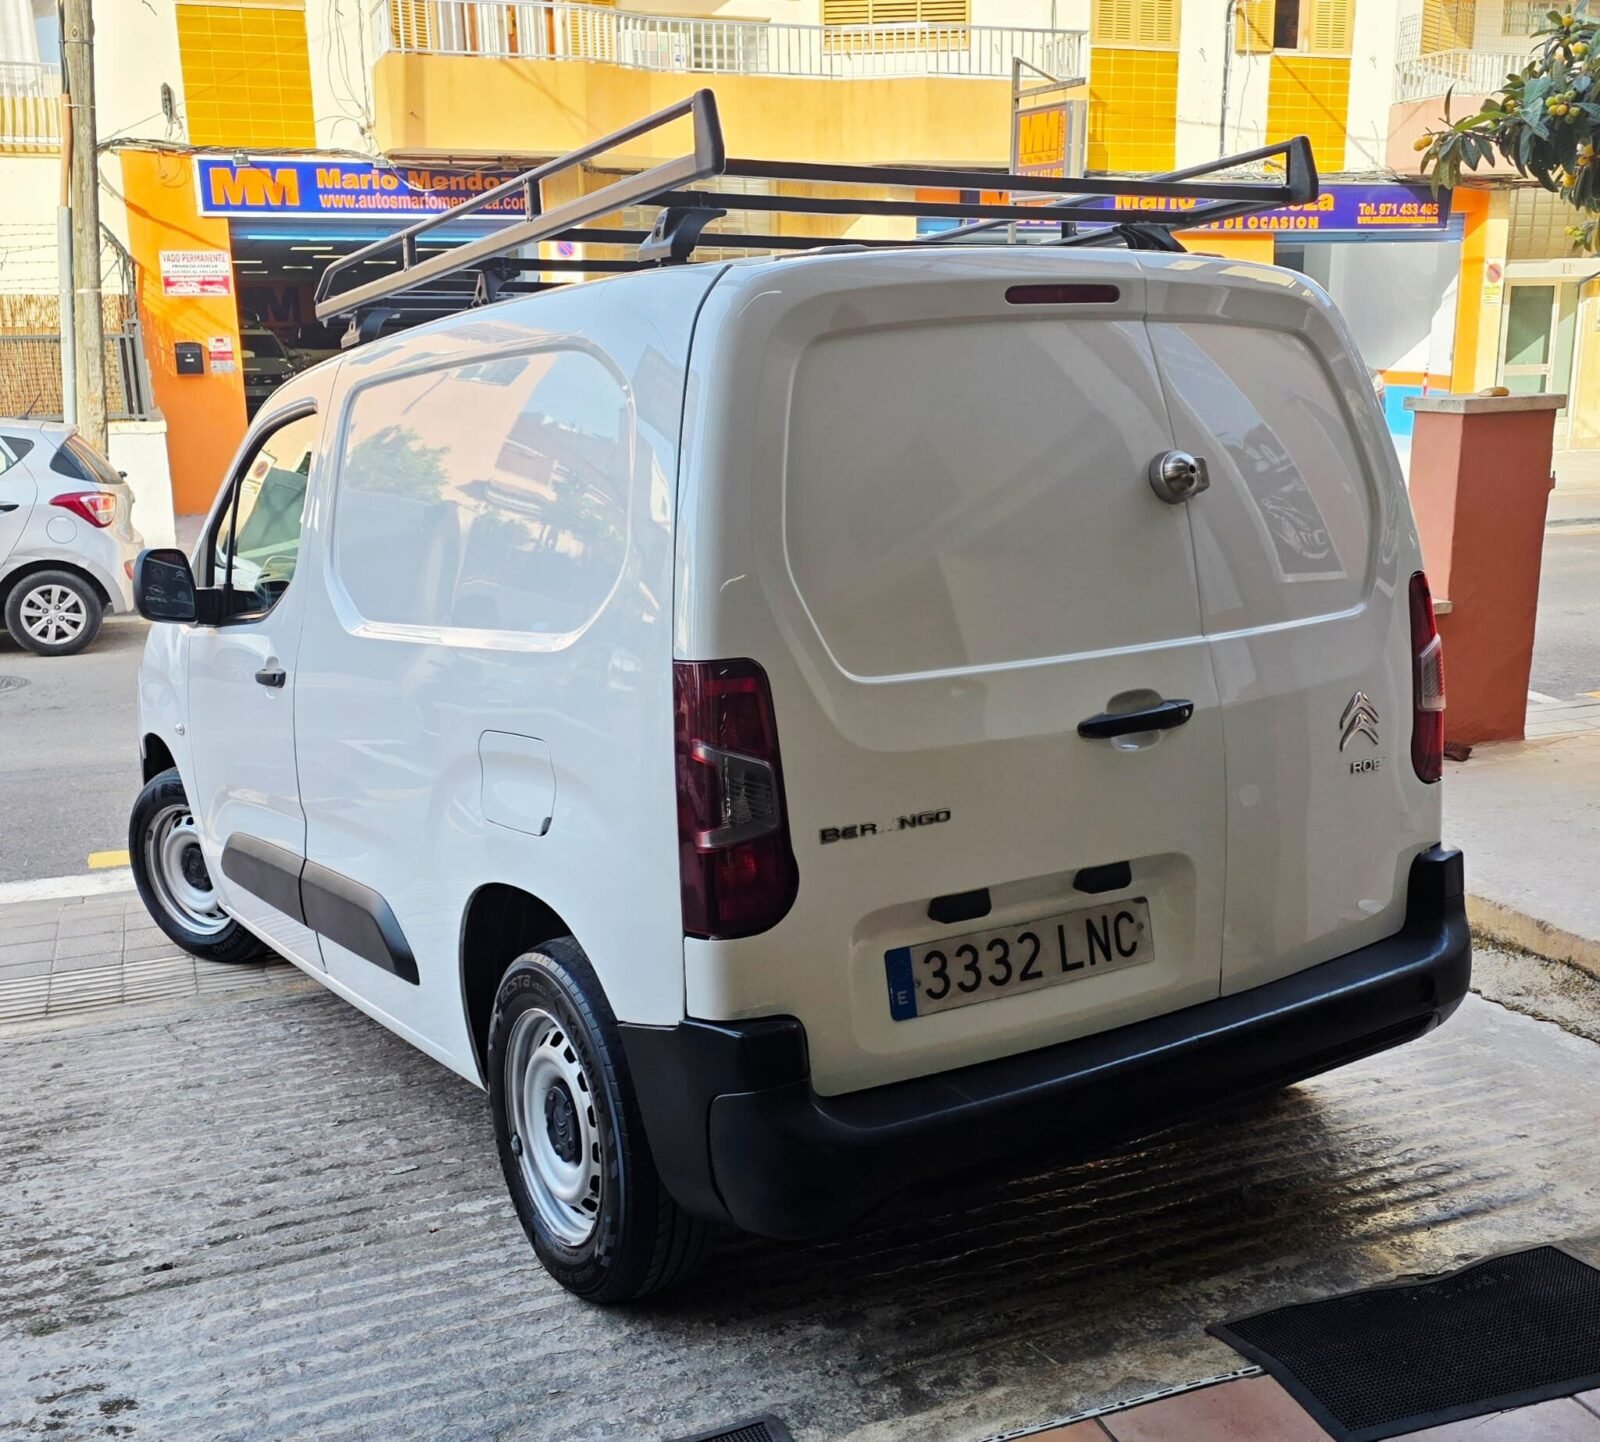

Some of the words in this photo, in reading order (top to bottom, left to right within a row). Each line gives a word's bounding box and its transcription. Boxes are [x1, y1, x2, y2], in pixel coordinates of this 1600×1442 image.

[1019, 111, 1059, 154] MM
[209, 167, 300, 206] MM
[316, 168, 399, 190] Mario
[1358, 203, 1378, 216] Tel.
[1379, 203, 1398, 216] 971
[1399, 203, 1419, 216] 433
[1247, 216, 1319, 230] OCASION
[162, 253, 181, 262] VADO
[182, 253, 227, 263] PERMANENTE
[923, 932, 1043, 1000] 3332
[1057, 911, 1139, 973] LNC
[897, 990, 909, 1005] E
